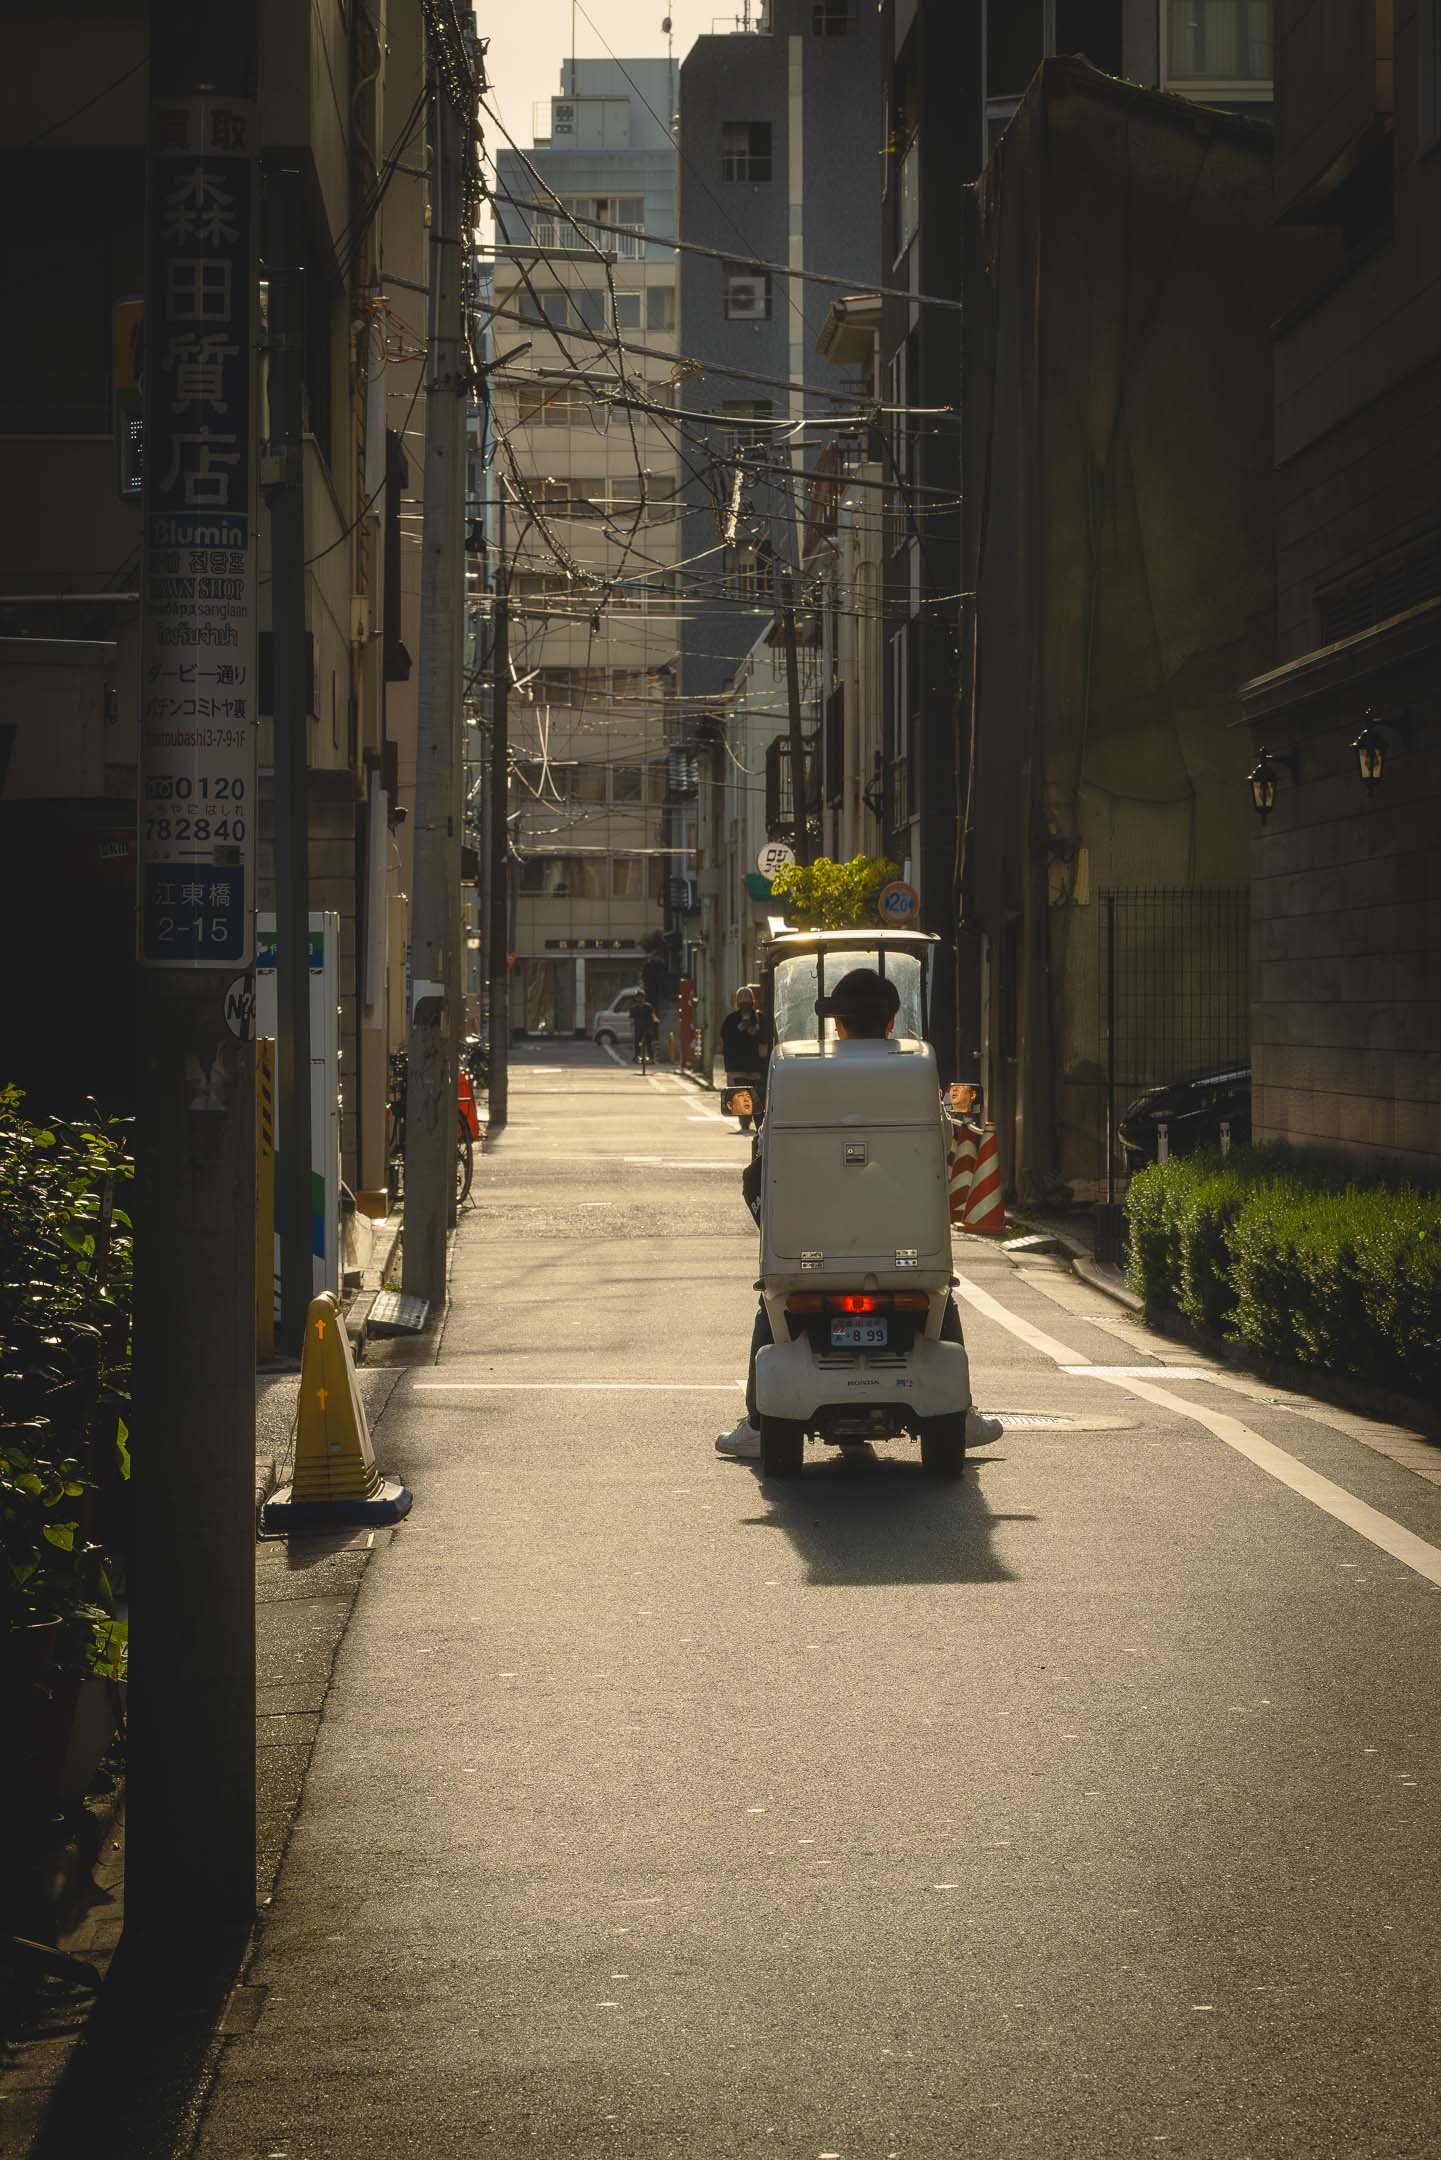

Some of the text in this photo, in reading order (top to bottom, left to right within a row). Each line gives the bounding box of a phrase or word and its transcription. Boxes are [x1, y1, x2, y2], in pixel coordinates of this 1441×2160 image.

[159, 166, 240, 505] 森田質店
[198, 577, 245, 601] SHOP
[175, 776, 245, 801] 0120
[143, 818, 246, 842] 782840
[153, 883, 231, 907] 江東橋
[158, 916, 228, 943] 2-15
